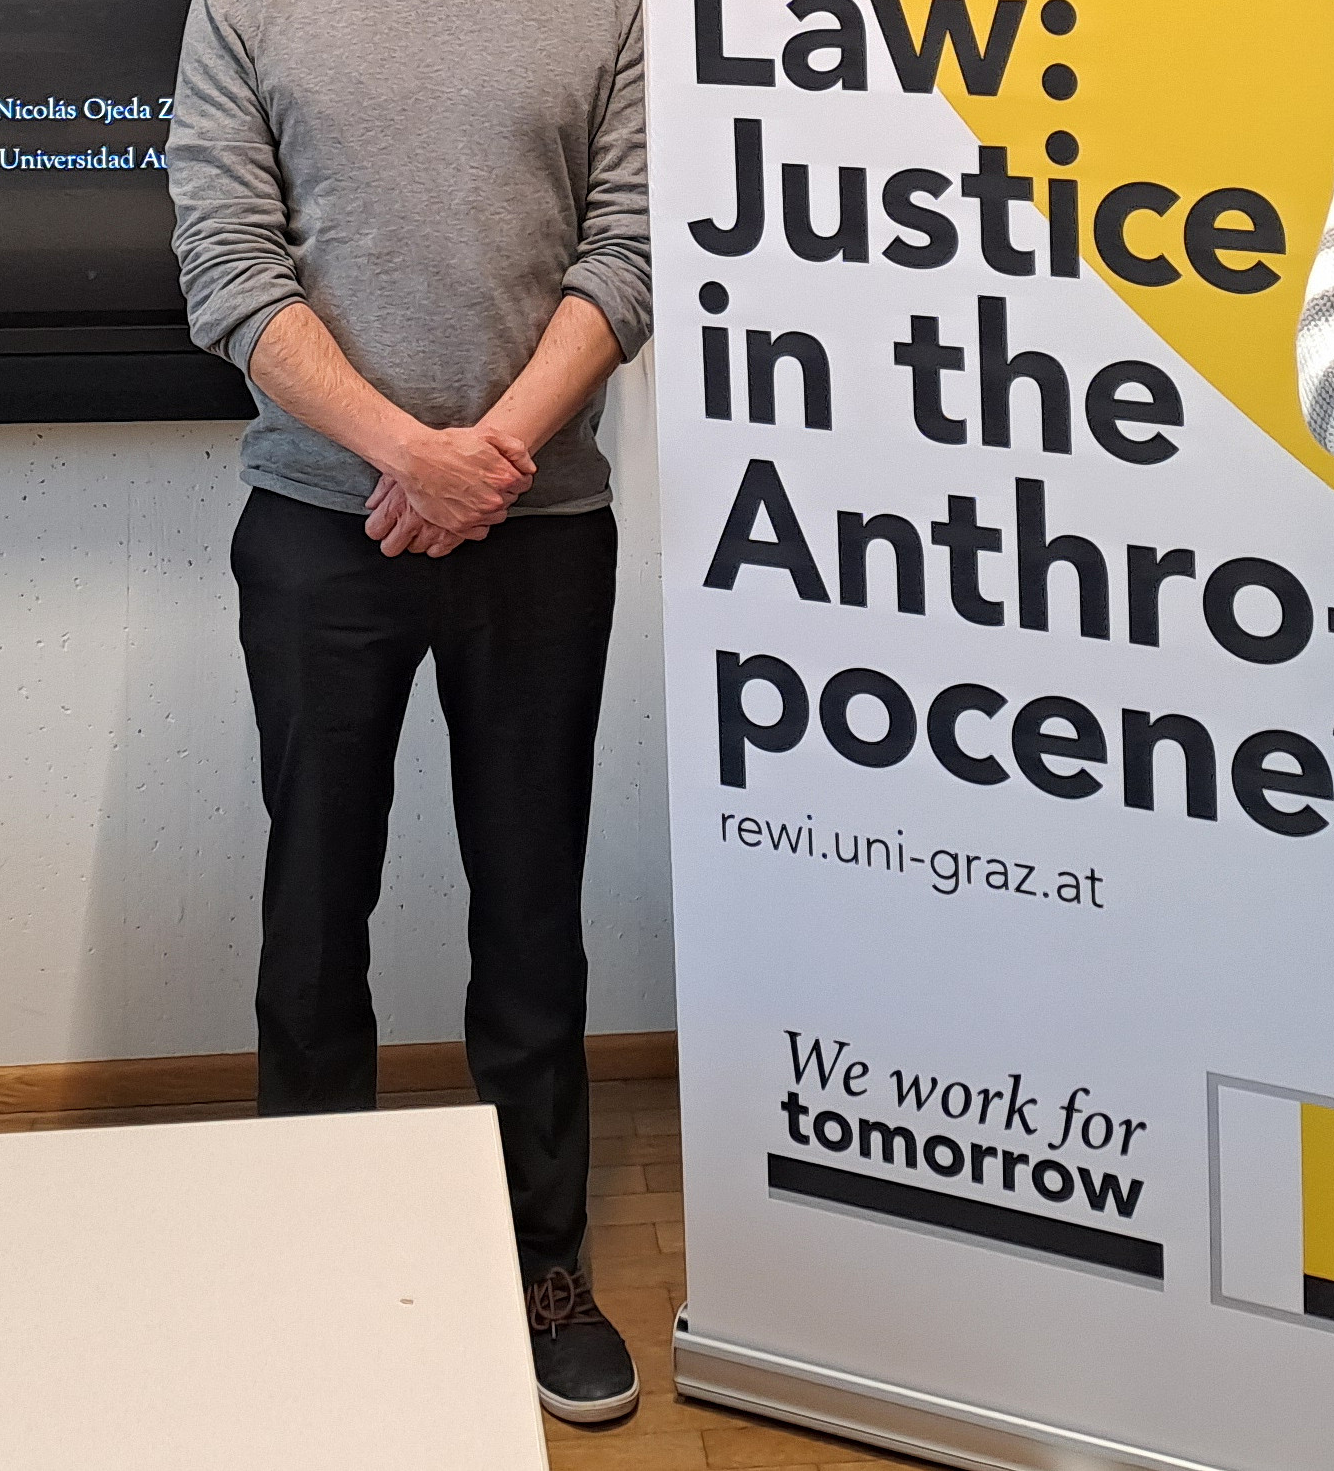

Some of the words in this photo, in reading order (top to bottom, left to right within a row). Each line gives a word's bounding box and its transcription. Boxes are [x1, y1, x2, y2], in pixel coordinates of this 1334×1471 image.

[83, 96, 152, 124] Ojeda
[687, 117, 1286, 295] Justice
[698, 281, 833, 431] in
[894, 295, 1185, 465] the
[721, 812, 1104, 909] rewi.uni-graz.at
[780, 1091, 1145, 1219] tomorrow
[783, 1029, 869, 1097] We
[889, 1069, 1038, 1136] work
[1048, 1088, 1148, 1157] for
